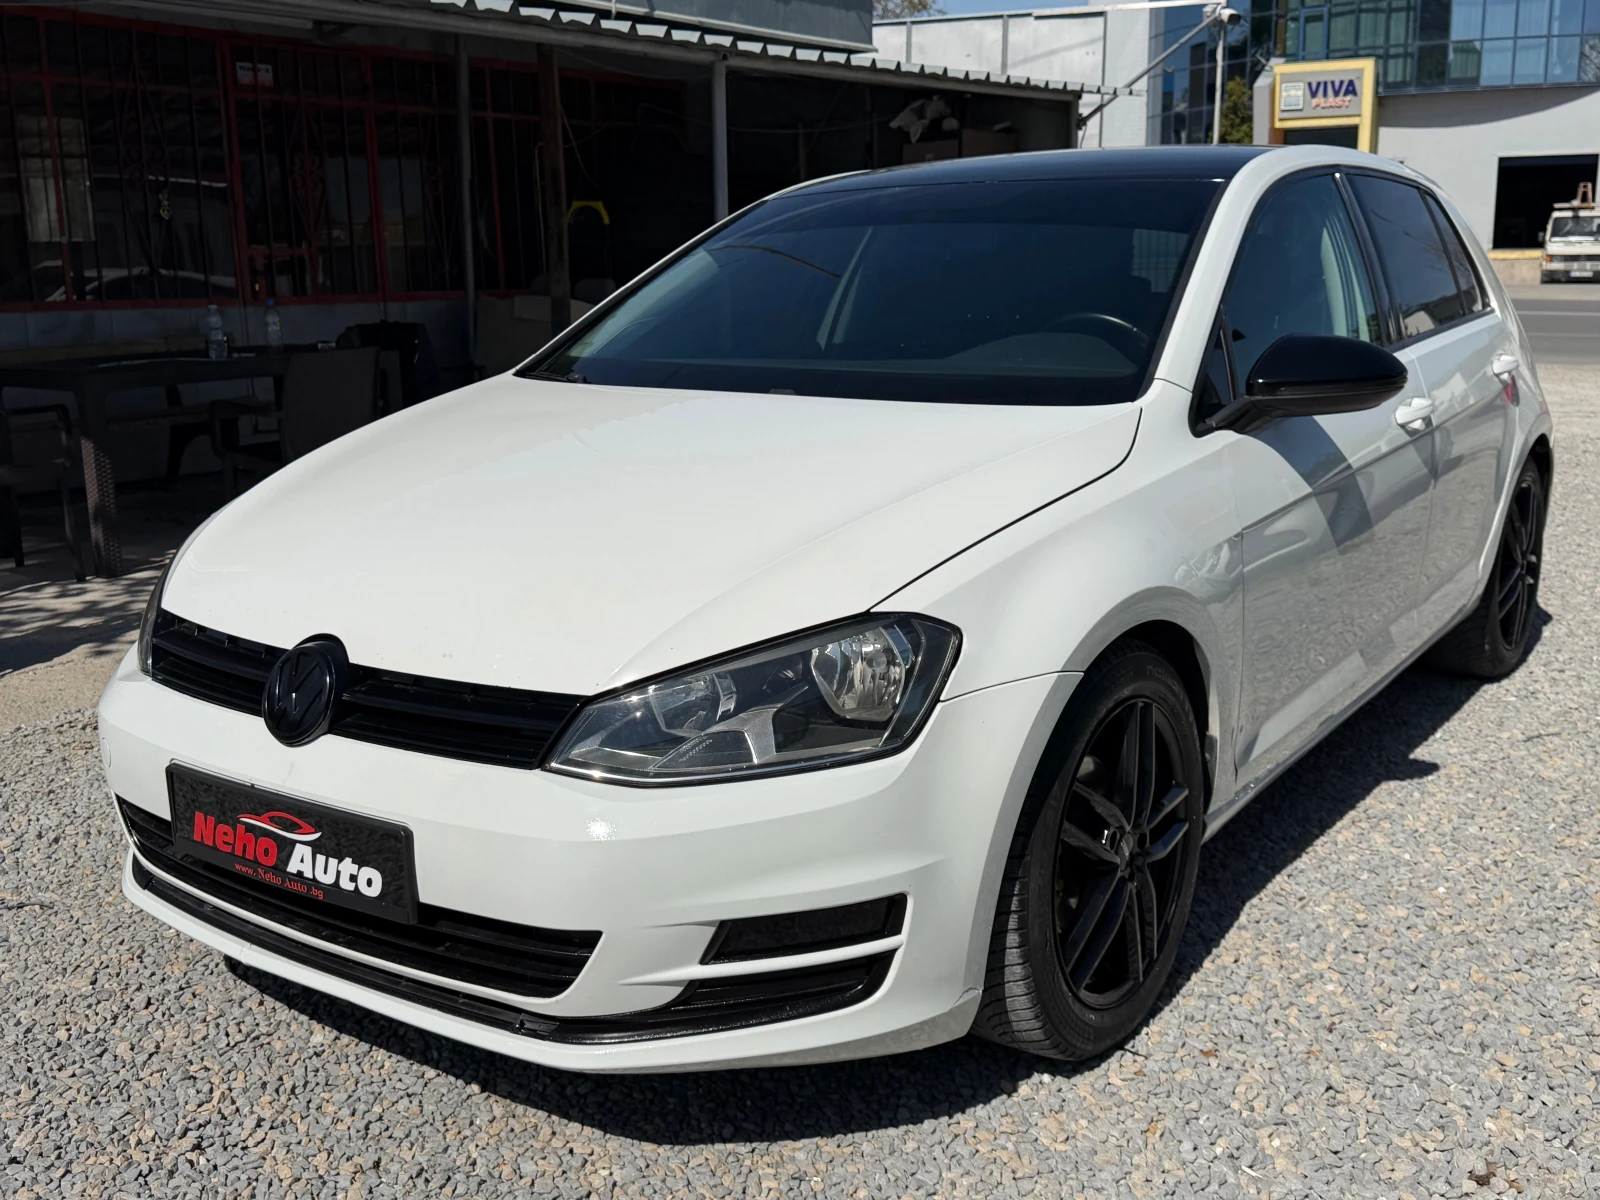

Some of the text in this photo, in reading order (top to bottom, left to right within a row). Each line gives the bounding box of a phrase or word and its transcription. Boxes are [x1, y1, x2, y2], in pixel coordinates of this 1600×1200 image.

[1307, 79, 1358, 98] VIVA
[1311, 97, 1351, 110] PLAST
[193, 811, 383, 898] Neho Auto
[257, 867, 282, 885] Neho
[284, 878, 307, 893] Auto
